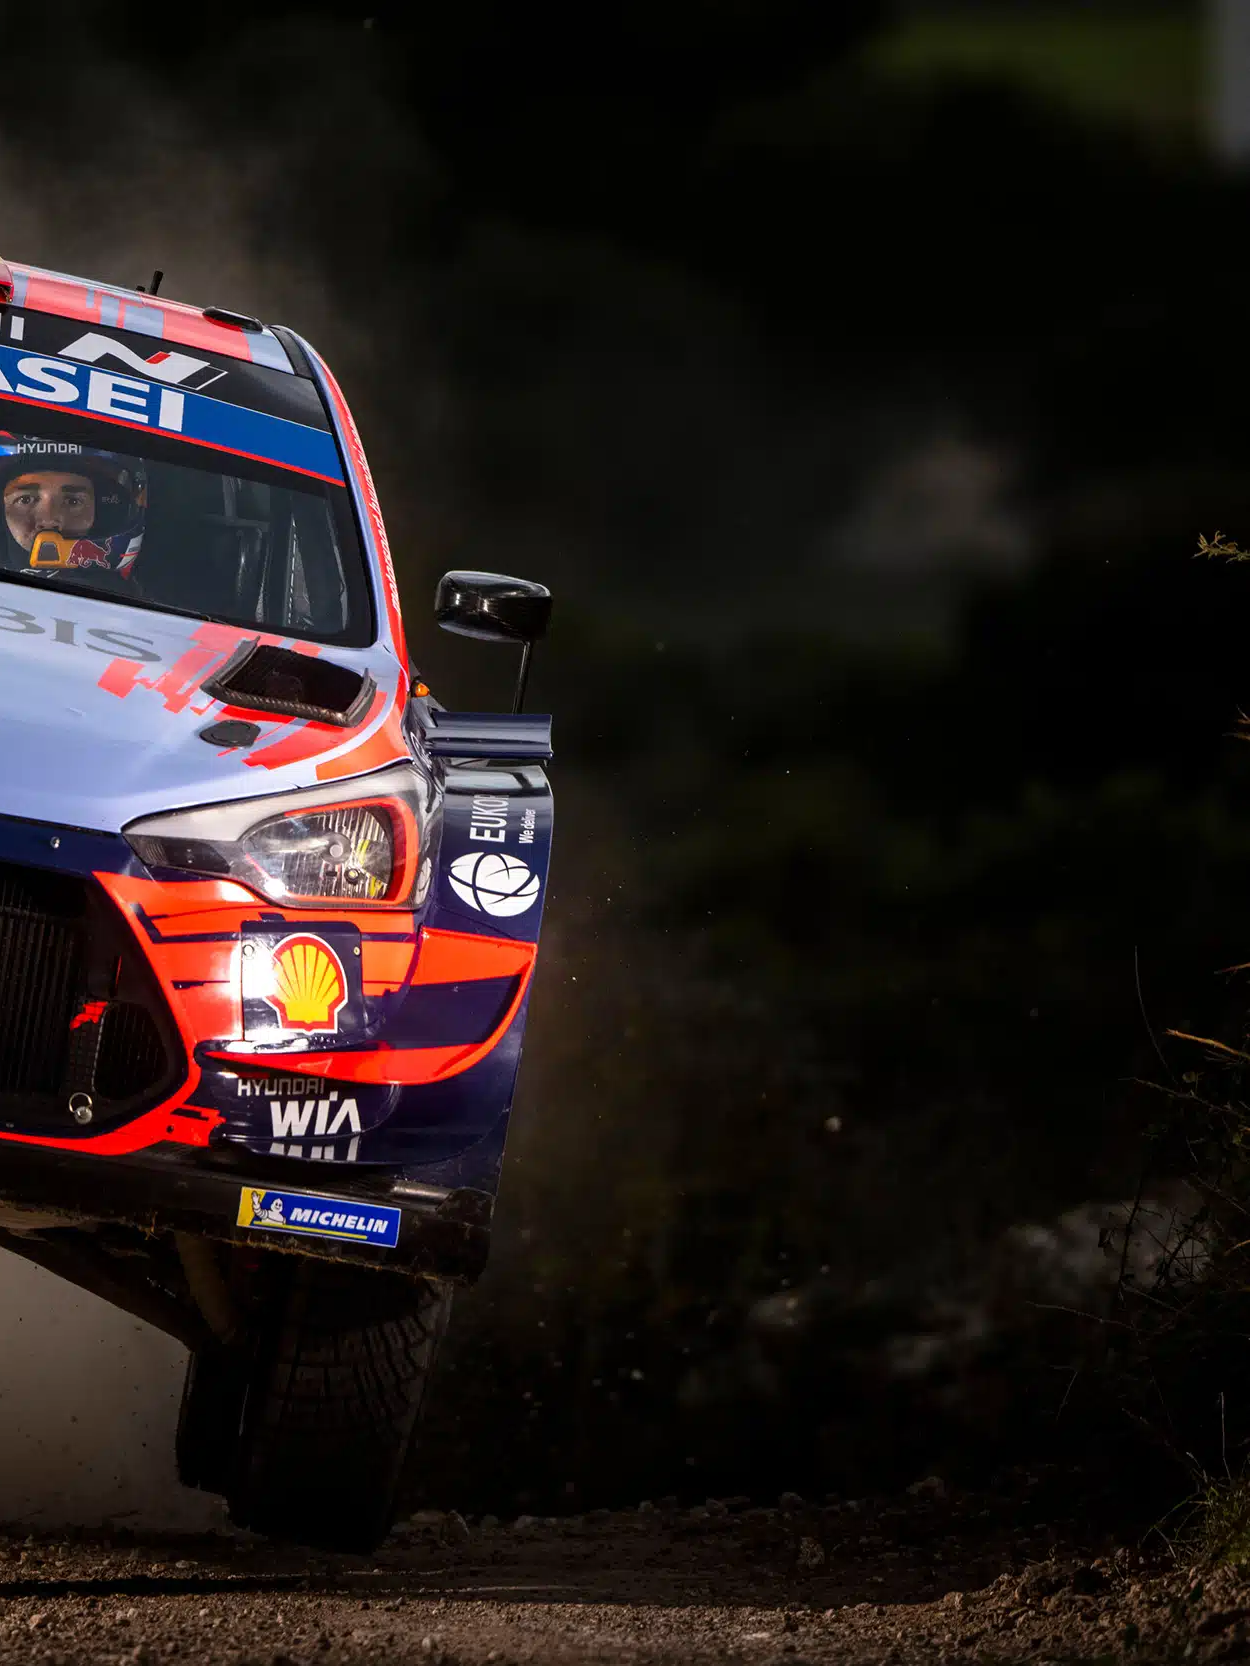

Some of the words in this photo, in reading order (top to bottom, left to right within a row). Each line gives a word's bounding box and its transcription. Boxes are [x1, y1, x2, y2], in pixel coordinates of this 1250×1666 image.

[16, 443, 82, 455] HYUNDAI
[237, 1078, 325, 1097] HYUNDAI
[270, 1091, 362, 1138] WIA
[290, 1207, 389, 1233] MICHELIN
